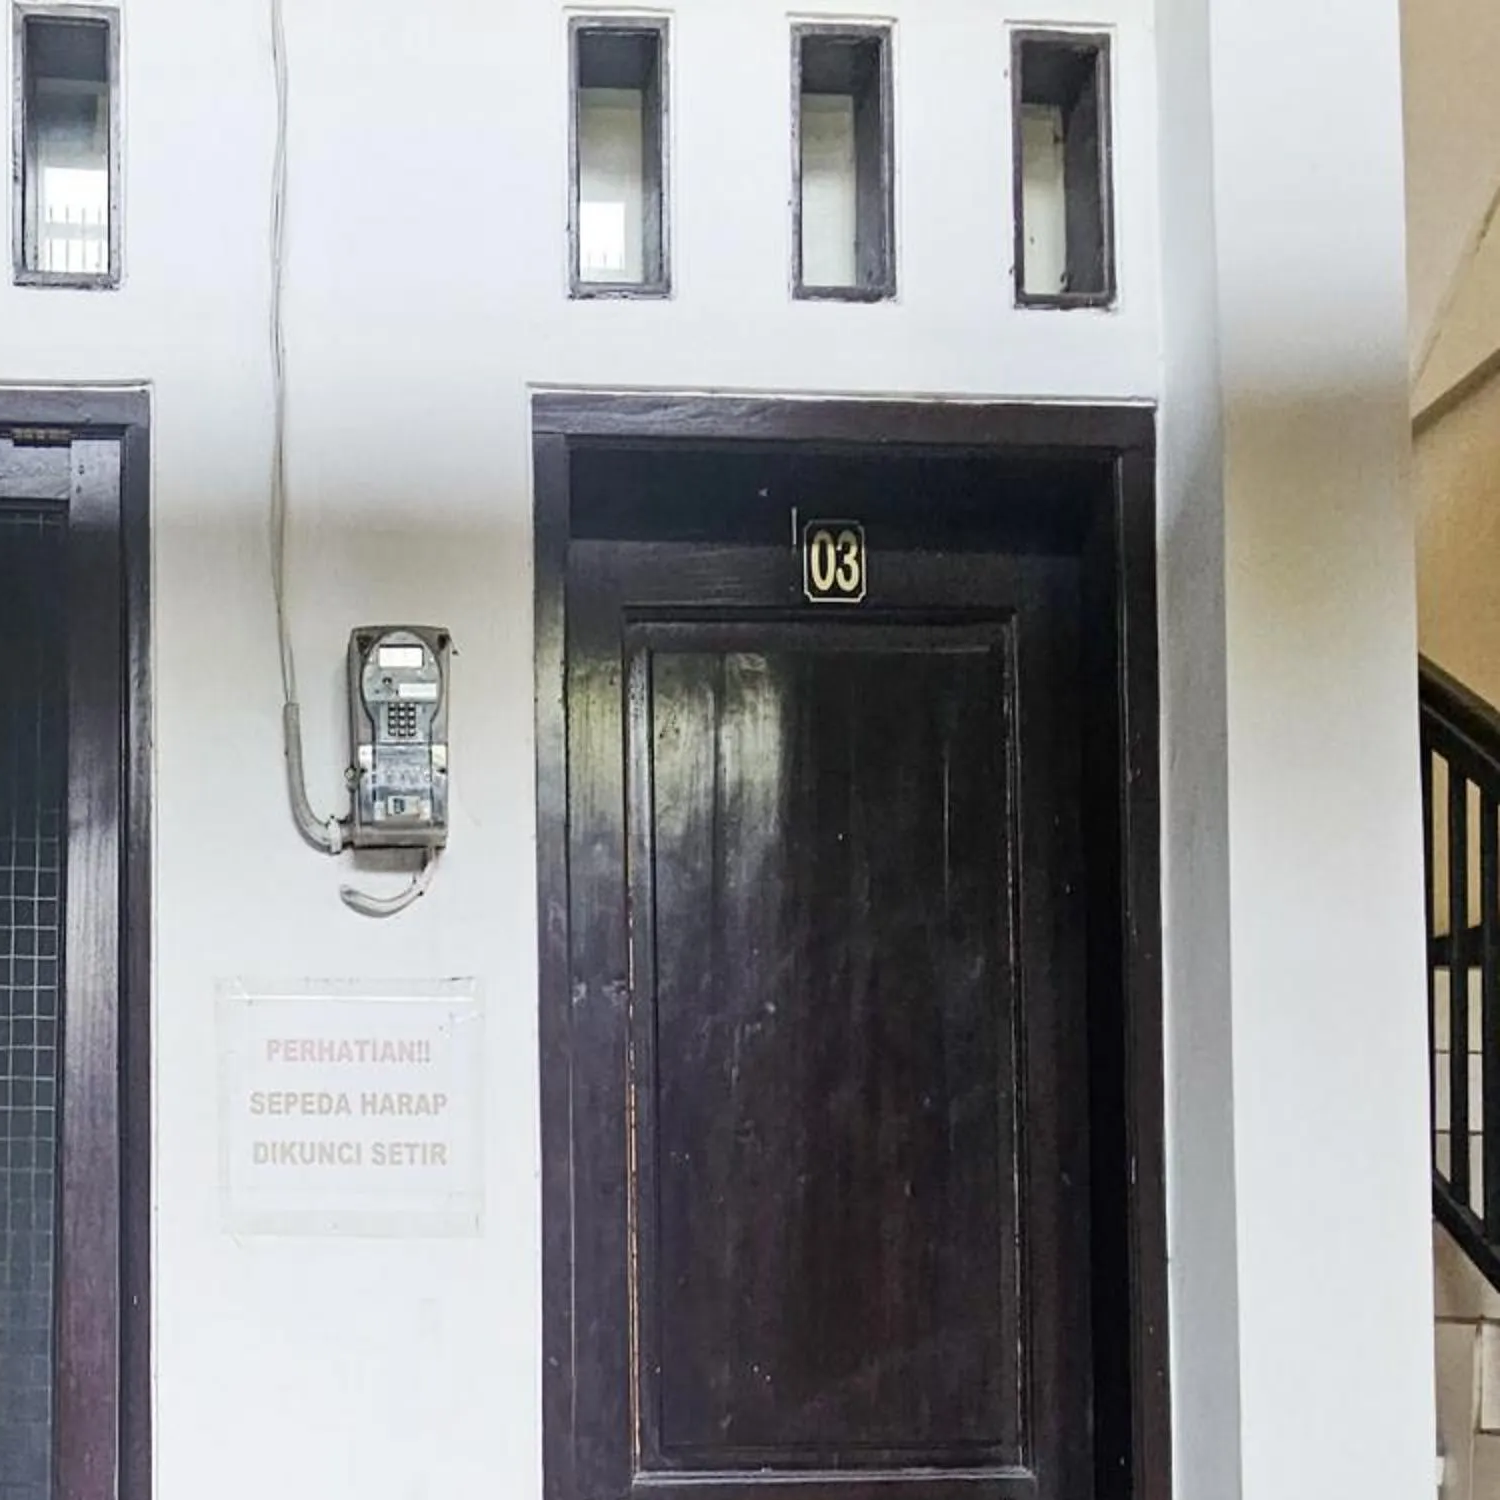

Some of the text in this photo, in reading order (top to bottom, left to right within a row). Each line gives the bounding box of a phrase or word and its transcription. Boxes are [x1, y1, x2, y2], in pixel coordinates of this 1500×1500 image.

[811, 529, 860, 591] 03
[266, 1038, 431, 1063] PERHATIAN!!
[249, 1091, 448, 1116] SEPEDA HARAP
[253, 1141, 448, 1166] DIKUNCI SETIR
